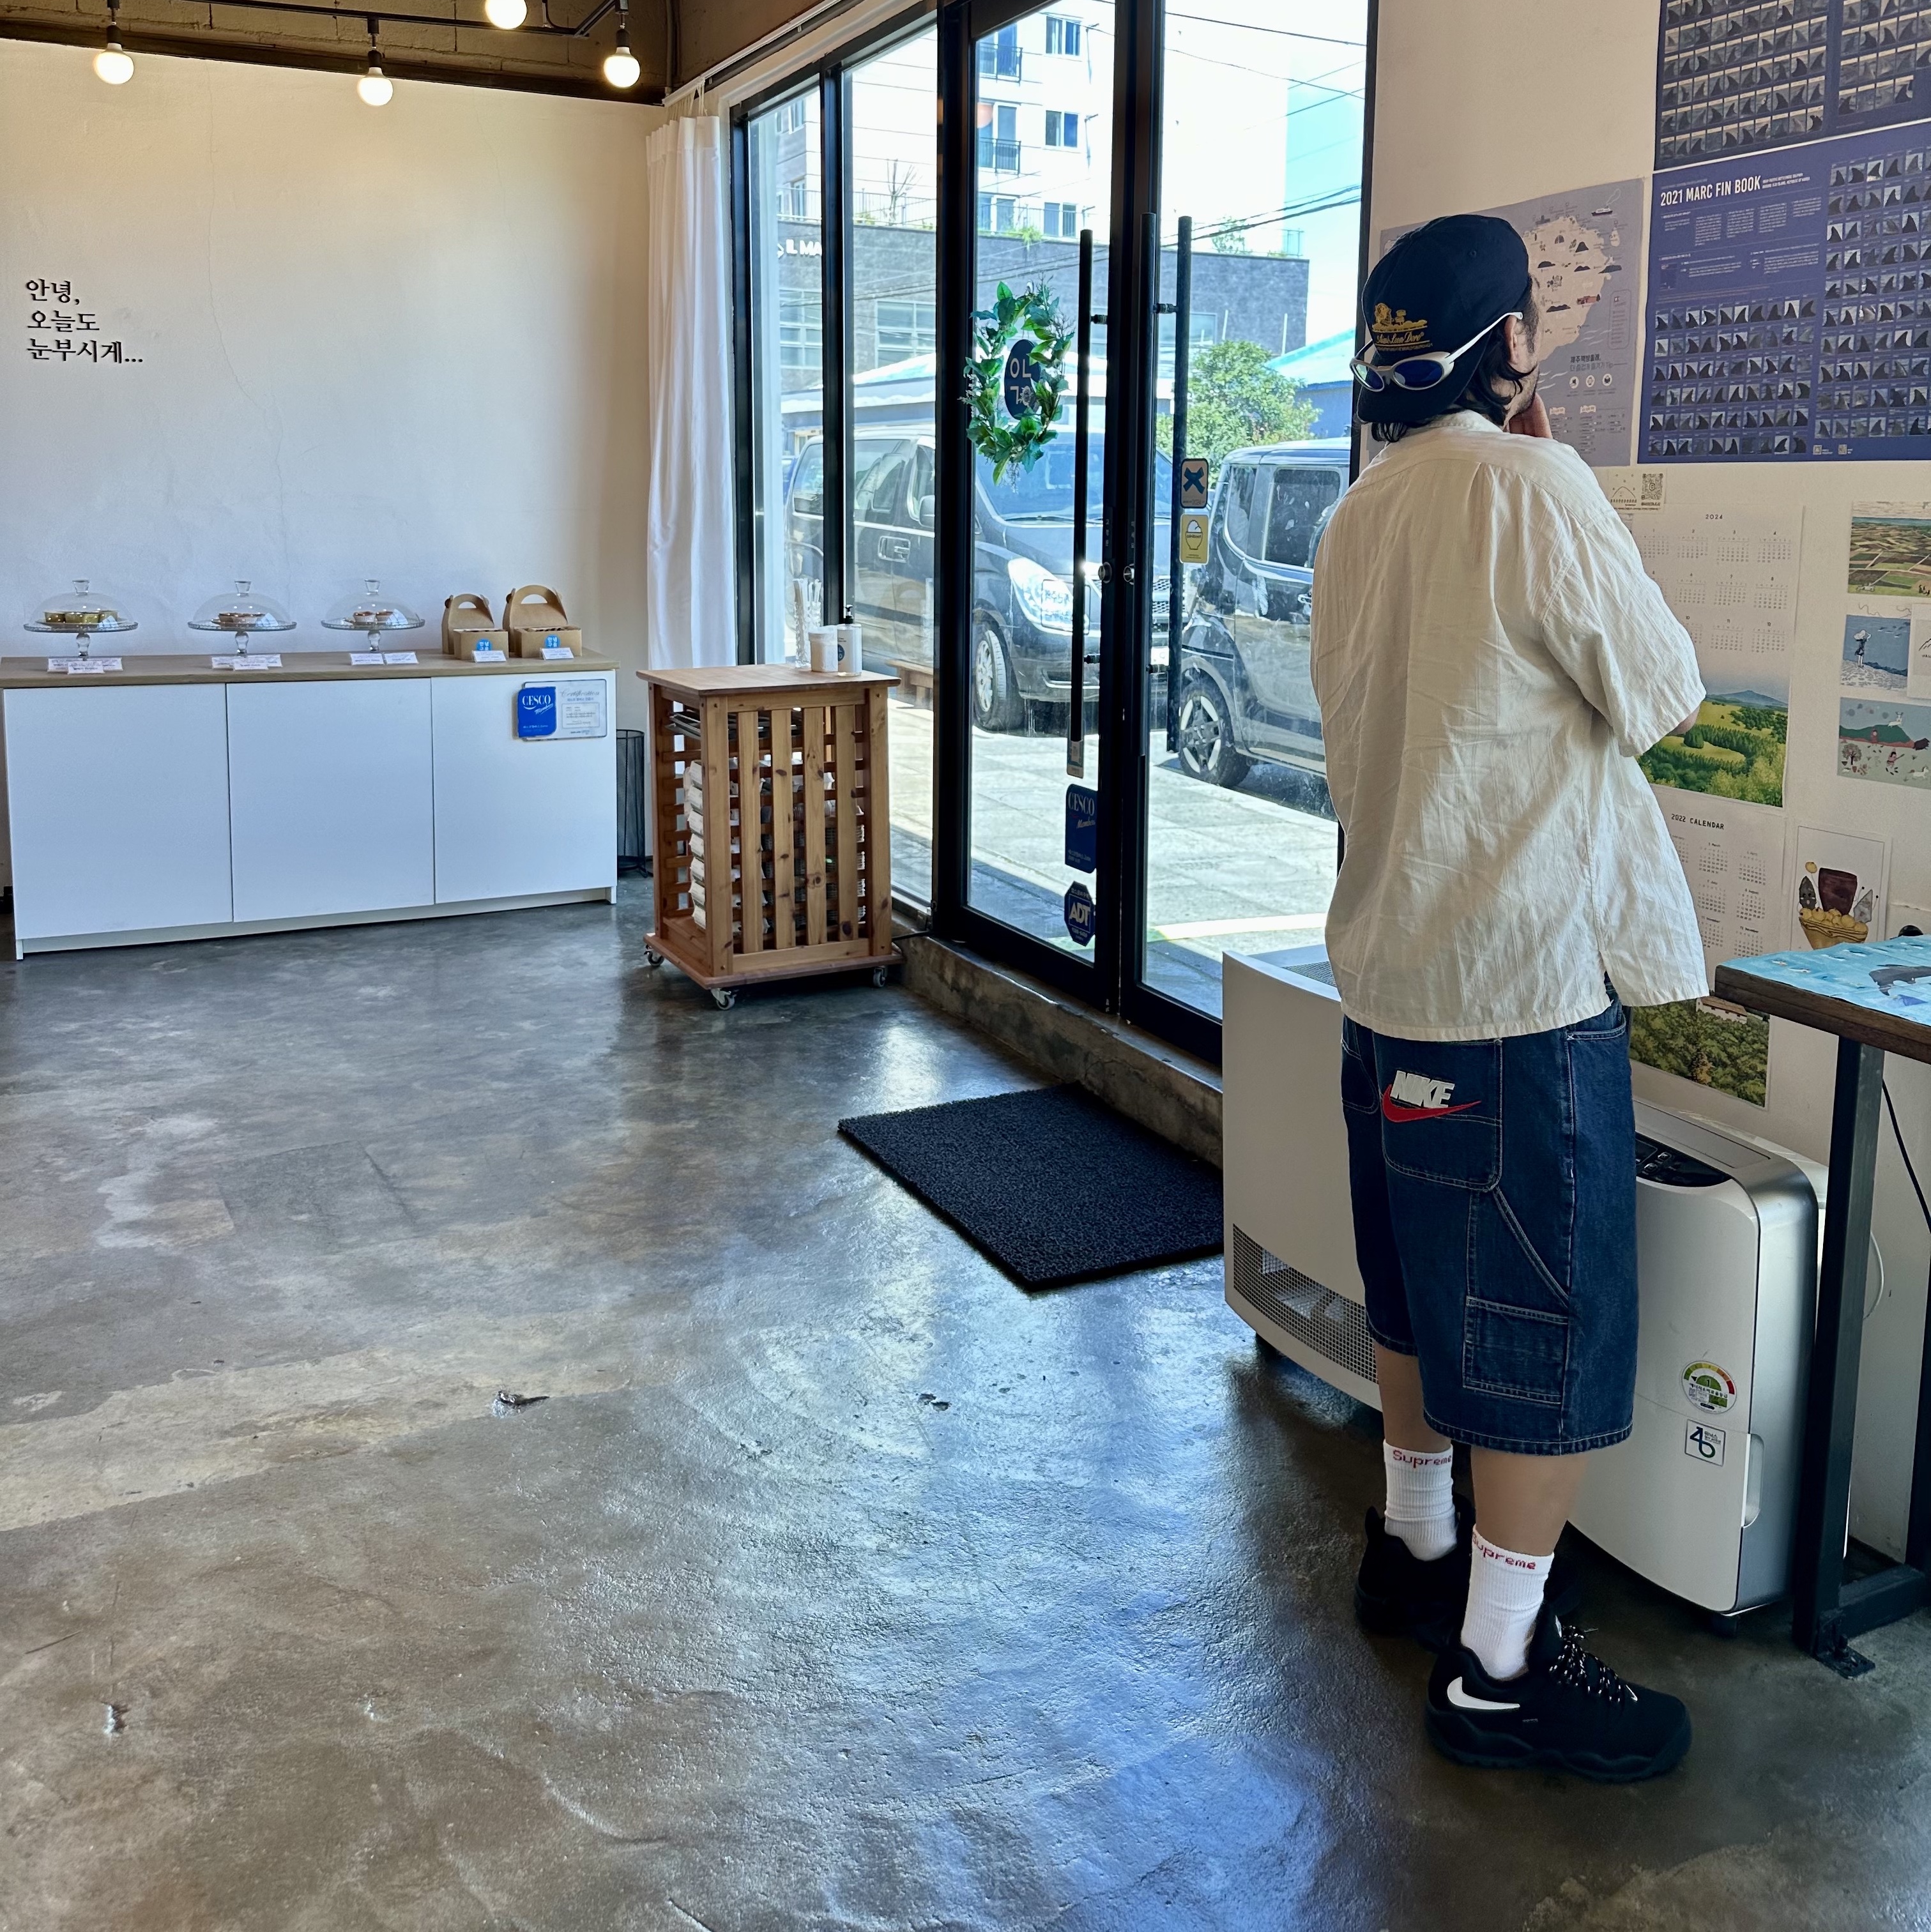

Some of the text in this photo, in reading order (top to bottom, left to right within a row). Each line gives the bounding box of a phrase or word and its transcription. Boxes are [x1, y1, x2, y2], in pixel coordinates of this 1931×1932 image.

[1660, 188, 1683, 207] 2021
[1686, 184, 1713, 202] MARC
[1715, 180, 1732, 197] FIN
[1734, 175, 1762, 194] BOOK
[26, 278, 80, 305] 안녕,
[27, 310, 100, 333] 오늘도
[26, 338, 144, 364] 눈부시게...
[522, 694, 551, 706] CESCO
[1068, 791, 1095, 816] CESCO
[1671, 813, 1725, 830] 2022 CALENDAR
[1069, 901, 1091, 927] ADT
[1390, 1070, 1456, 1109] NIKE
[1706, 1379, 1711, 1387] 1
[1393, 1449, 1452, 1469] Supreme
